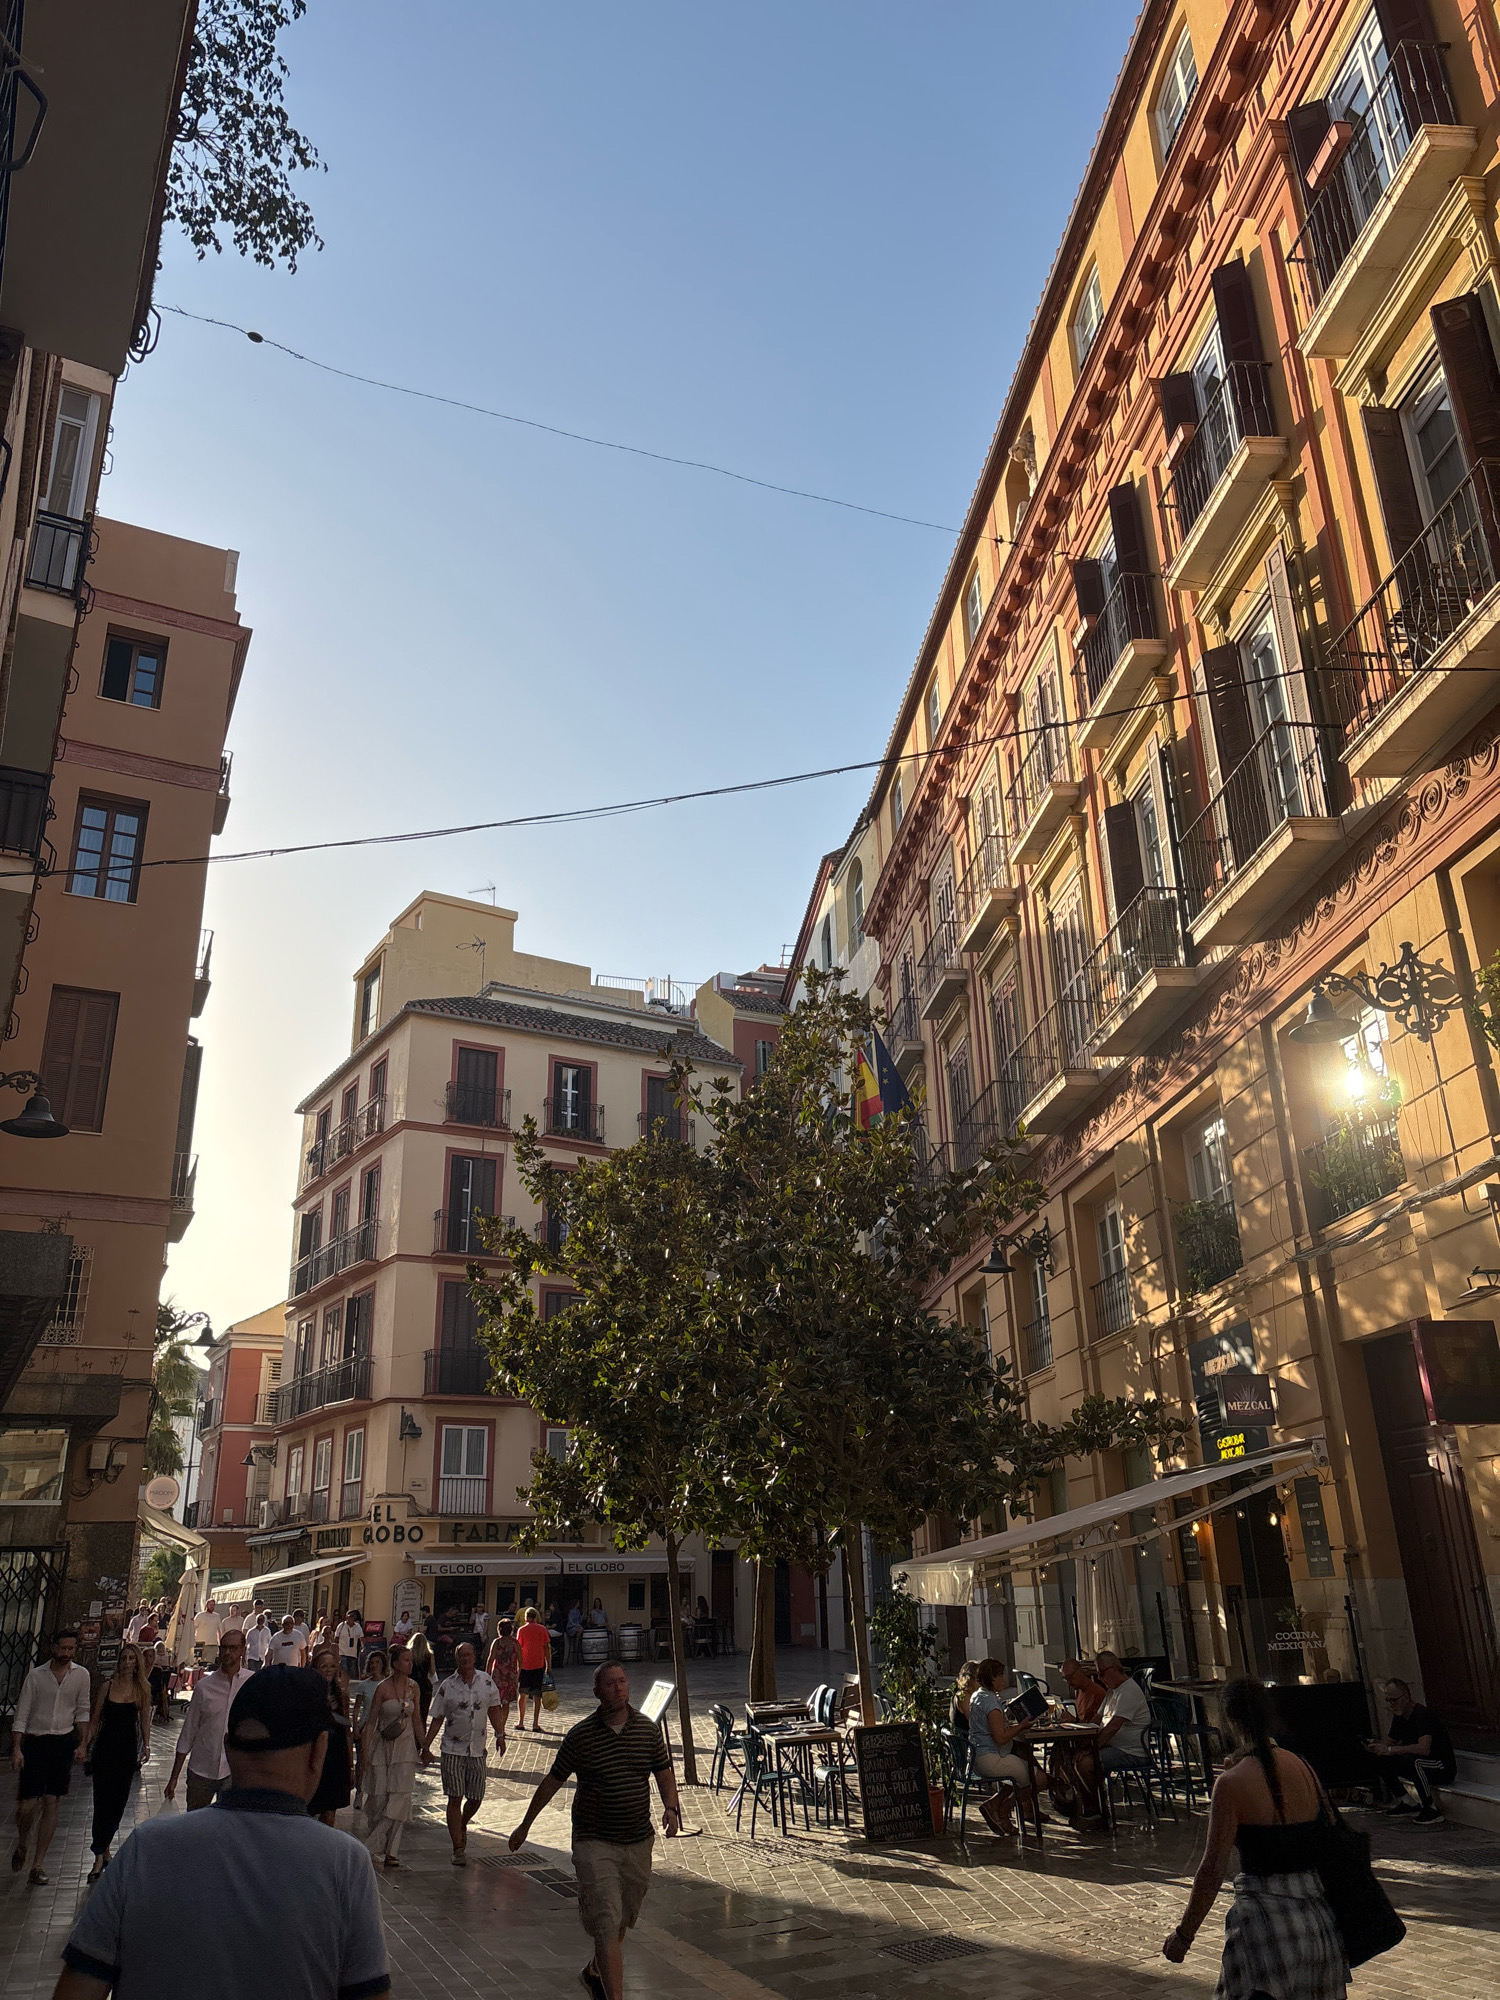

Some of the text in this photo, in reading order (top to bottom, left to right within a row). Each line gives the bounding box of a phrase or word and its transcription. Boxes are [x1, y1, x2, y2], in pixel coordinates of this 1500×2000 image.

[1227, 1400, 1271, 1411] MEZCAL
[1216, 1433, 1246, 1450] GASTROBAR
[1221, 1444, 1245, 1460] MEXICANO
[373, 1505, 396, 1522] EL
[363, 1525, 423, 1544] GLOBO
[452, 1523, 584, 1543] FARMIA
[420, 1564, 483, 1574] EL GLOBO
[568, 1563, 582, 1572] EL
[585, 1563, 625, 1572] GLOBO
[1275, 1630, 1320, 1641] COCINA
[865, 1772, 889, 1784] APEROL
[867, 1795, 894, 1809] MIMOSA
